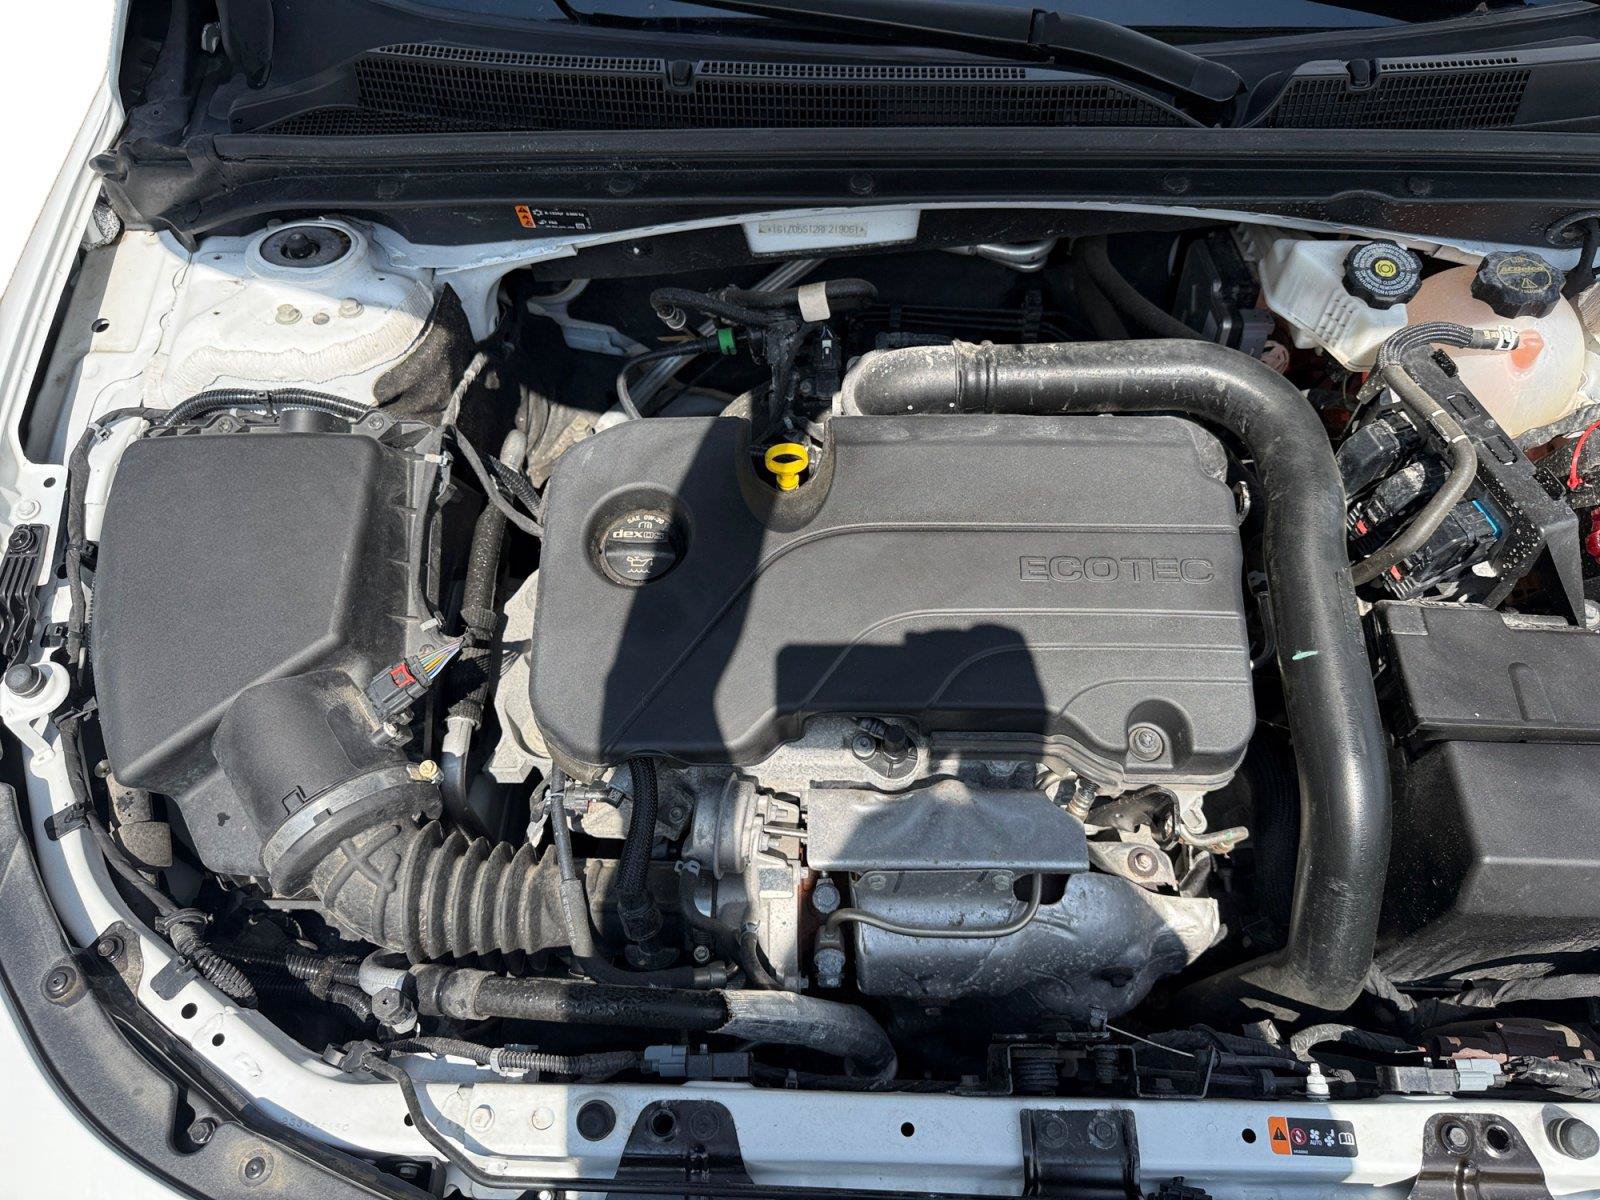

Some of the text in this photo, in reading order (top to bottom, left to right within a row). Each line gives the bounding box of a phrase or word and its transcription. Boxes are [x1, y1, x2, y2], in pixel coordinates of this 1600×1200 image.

[626, 514, 665, 525] SAE 0W-20
[1019, 555, 1215, 584] ECOTEC
